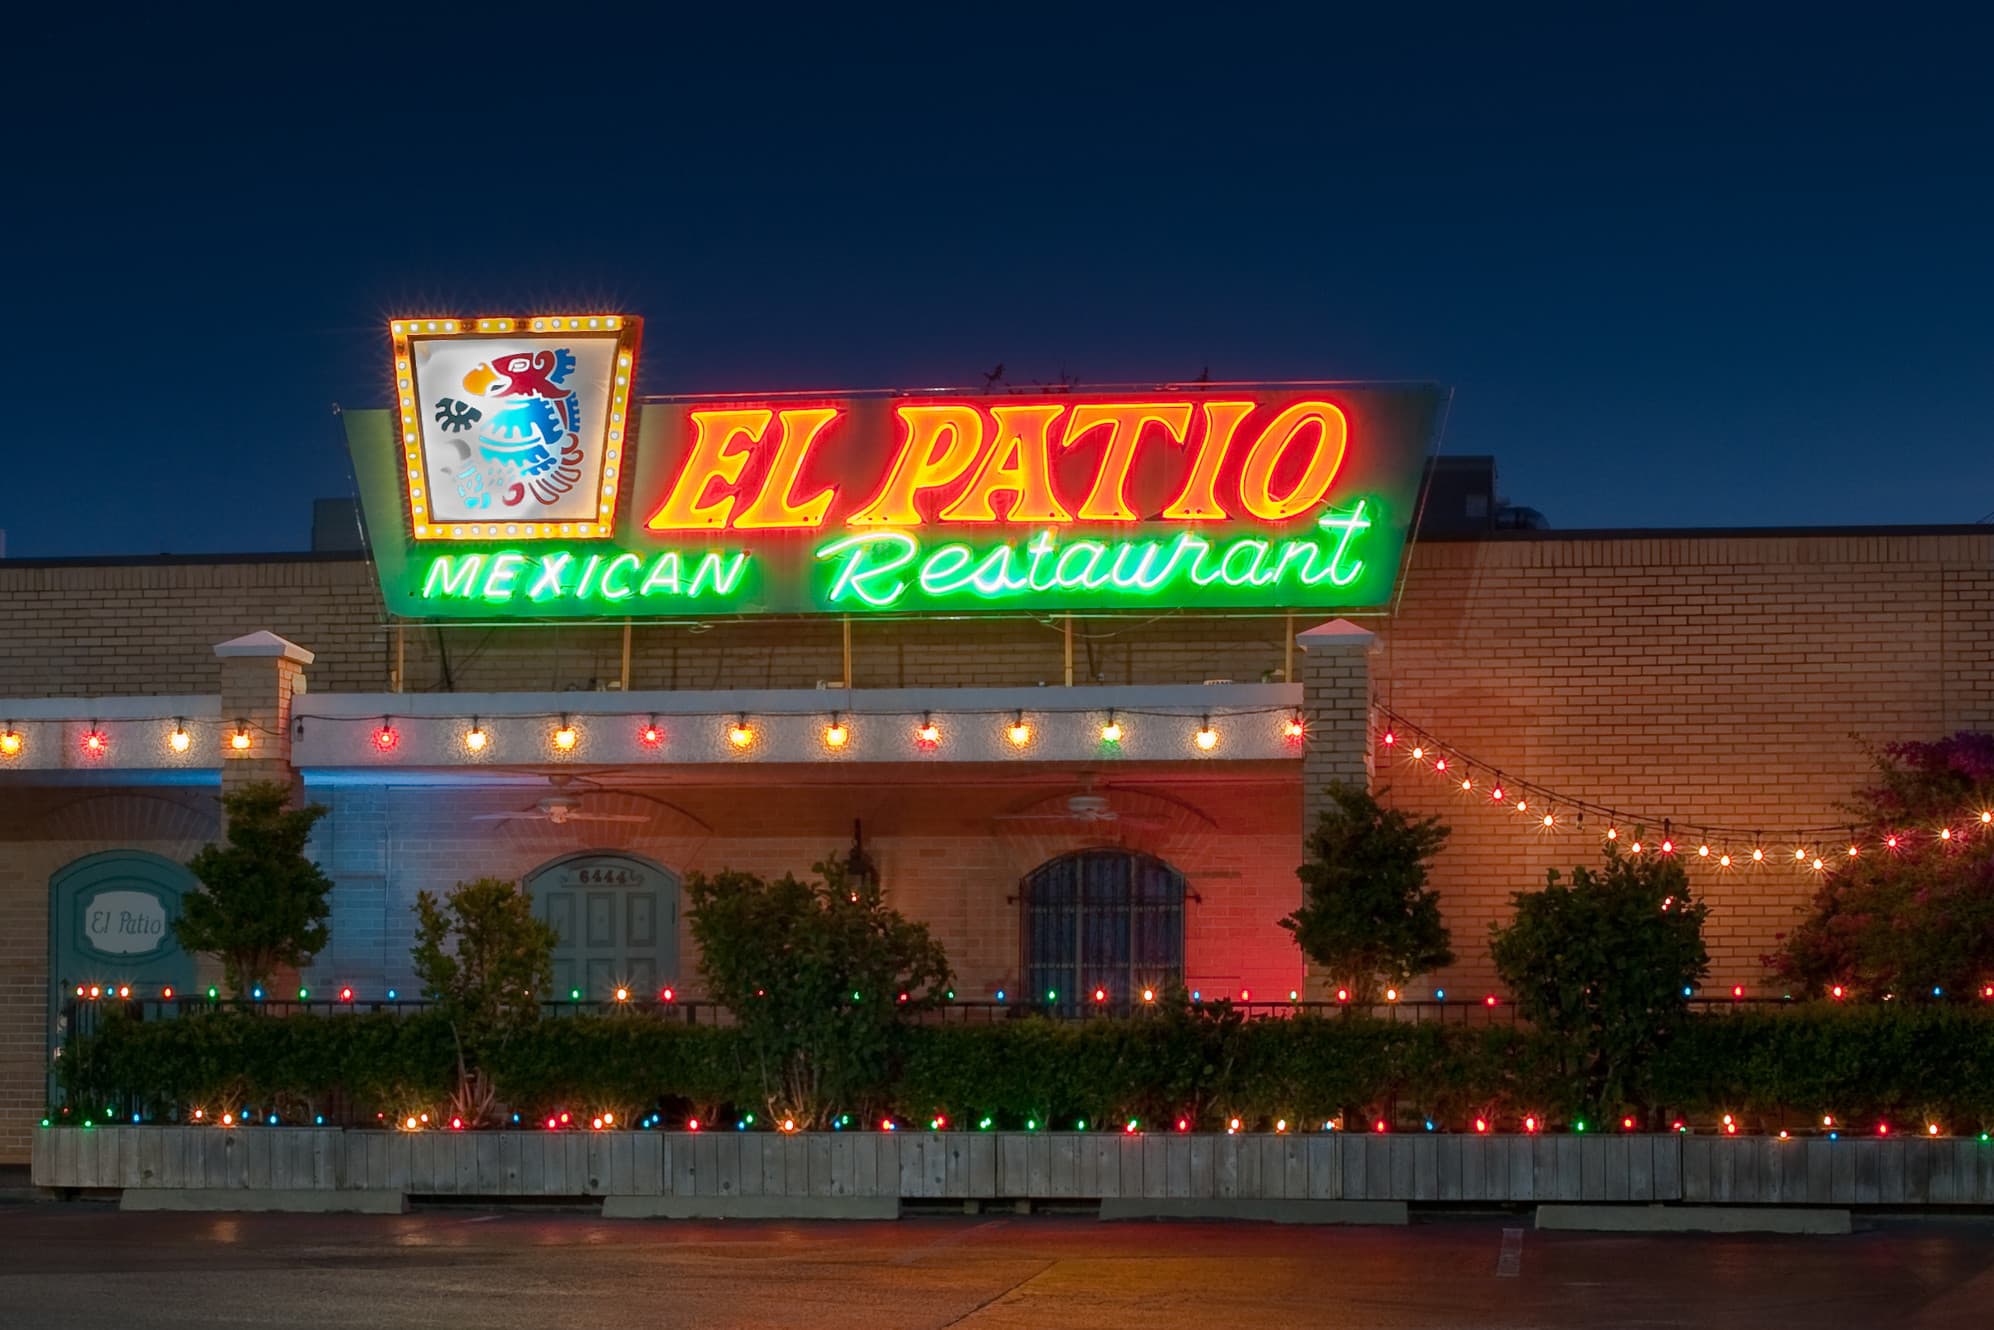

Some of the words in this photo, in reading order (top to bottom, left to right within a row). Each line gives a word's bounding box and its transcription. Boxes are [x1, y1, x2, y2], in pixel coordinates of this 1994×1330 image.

[643, 406, 839, 530] EL
[846, 401, 1348, 526] PATIO
[422, 552, 750, 600] MEXICAN
[816, 499, 1371, 604] Restaurant
[579, 869, 627, 884] 6444
[91, 911, 111, 934] El
[119, 911, 162, 935] Patio
